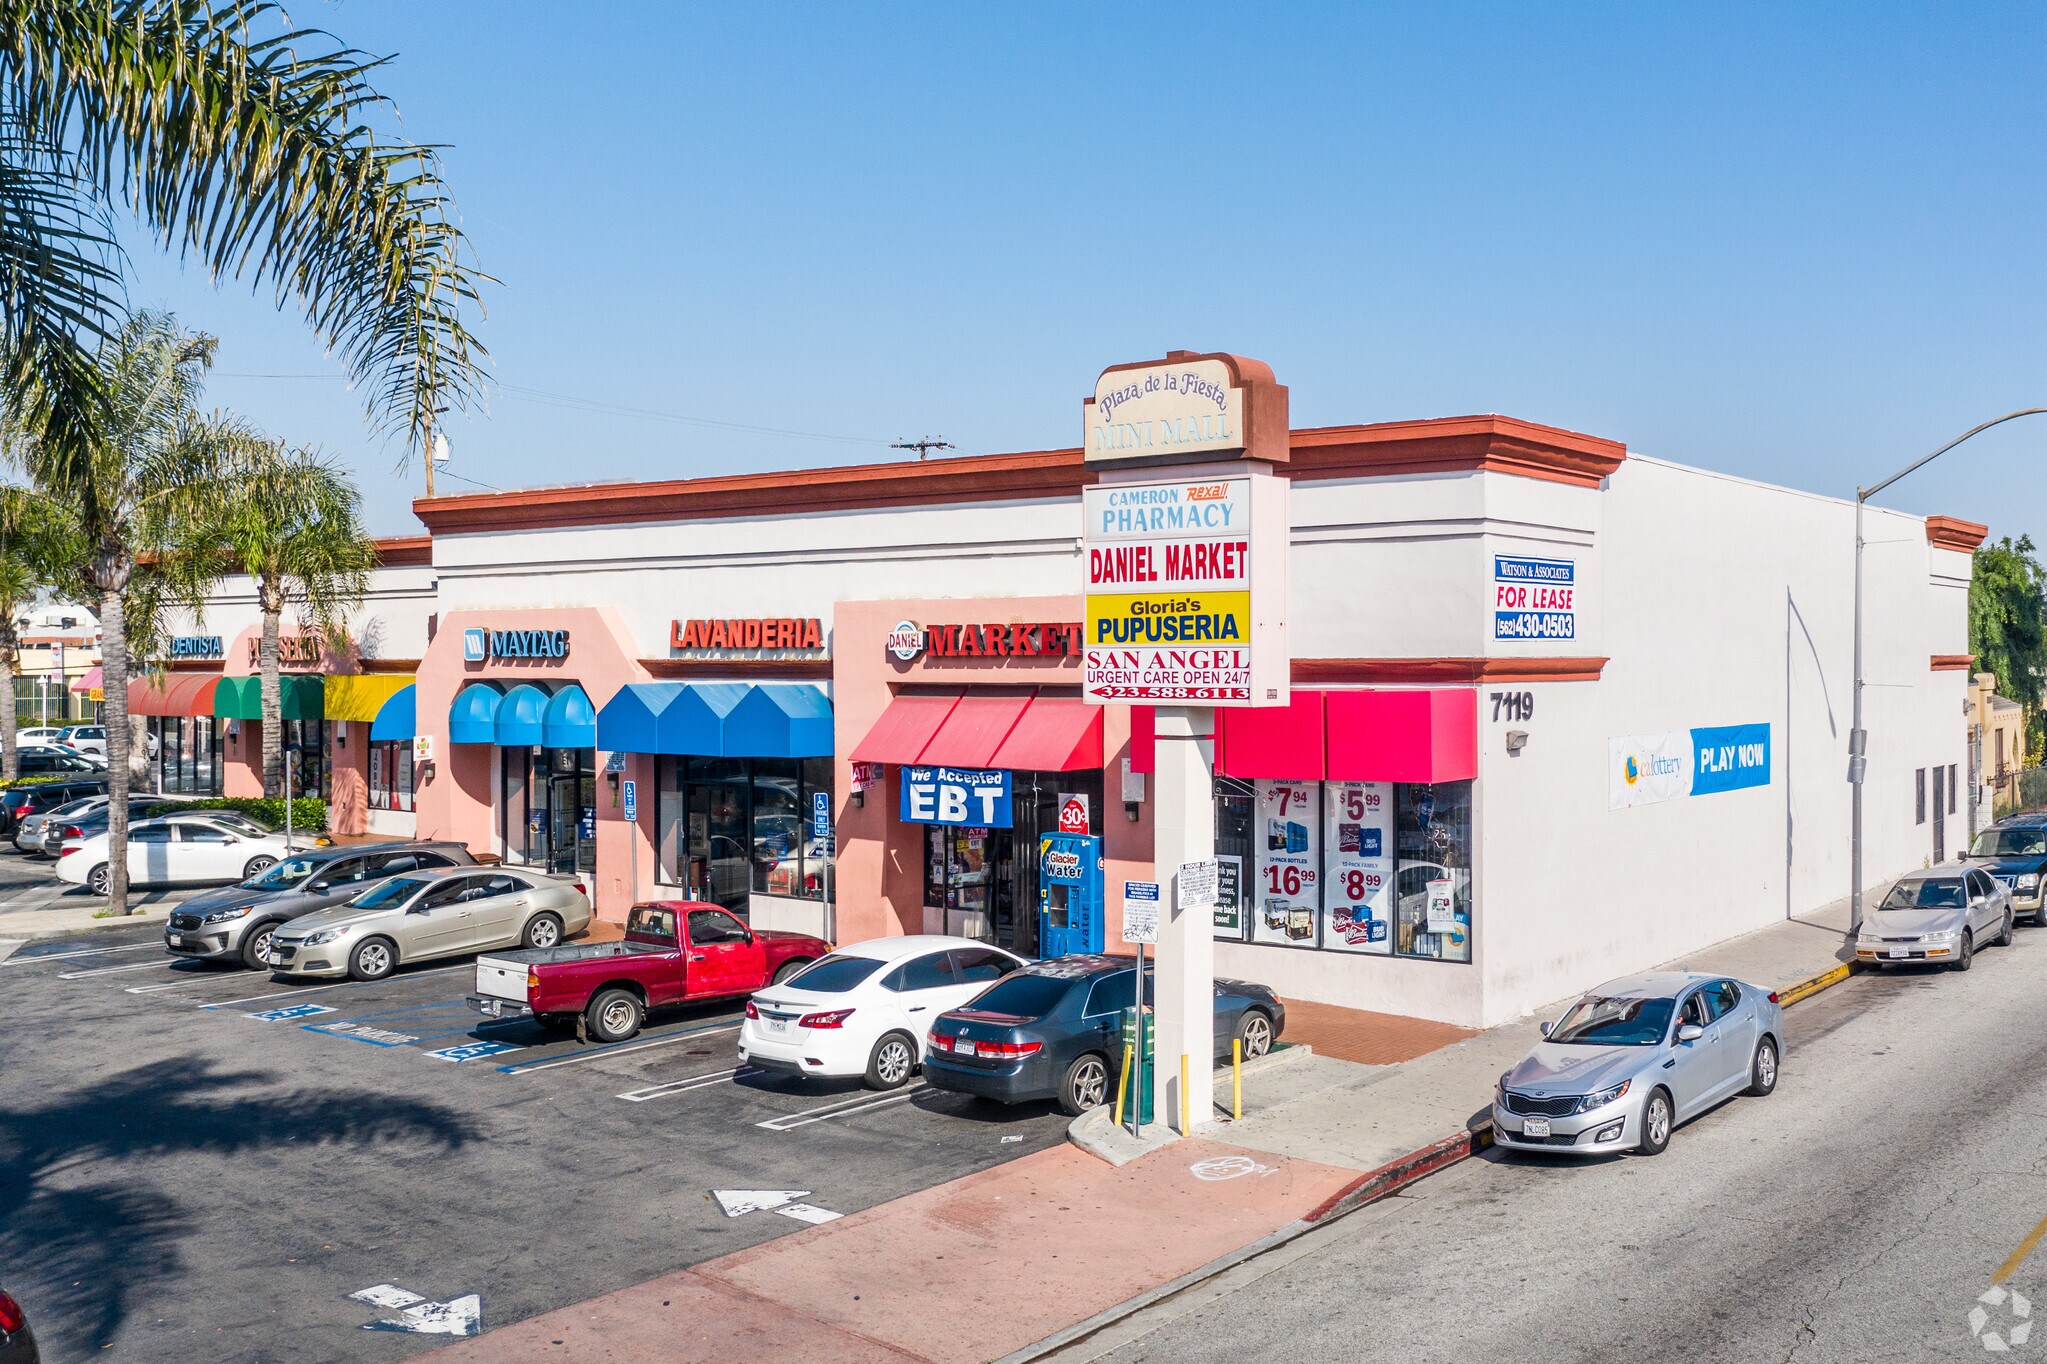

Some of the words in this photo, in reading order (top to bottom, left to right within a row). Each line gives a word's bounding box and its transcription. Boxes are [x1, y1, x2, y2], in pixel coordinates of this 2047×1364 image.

[1100, 384, 1143, 423] Plaza
[1144, 375, 1160, 393] de
[1164, 373, 1177, 391] la
[1180, 373, 1227, 411] Fiesta
[1095, 421, 1153, 451] MINI
[1161, 414, 1233, 445] MALL
[1109, 489, 1179, 507] CAMERON
[1103, 503, 1234, 533] PHARMACY
[1090, 546, 1158, 584] DANIEL
[1165, 542, 1248, 581] MARKET
[1528, 566, 1533, 577] &
[1130, 598, 1201, 616] Gloria's
[1497, 586, 1527, 608] FOR
[1532, 588, 1573, 610] LEASE
[671, 618, 823, 649] LAVANDERIA
[1097, 614, 1240, 643] PUPUSERIA
[172, 636, 222, 654] DENTISTA
[248, 636, 318, 661] PUSERIA
[490, 629, 567, 658] MAYTAG
[889, 633, 922, 649] DANIEL
[926, 622, 1084, 657] MARKET
[1087, 651, 1141, 670] SAN
[1148, 650, 1250, 670] ANGEL
[1087, 671, 1140, 684] URGENT
[1143, 671, 1179, 684] CARE
[1183, 671, 1220, 684] OPEN
[1224, 671, 1250, 684] 24/7
[1101, 686, 1249, 699] 323.588.6113
[1490, 691, 1533, 723] 7119
[1640, 754, 1682, 778] calottery
[1700, 746, 1735, 773] PLAY
[1738, 743, 1764, 768] NOW
[911, 768, 930, 783] We
[937, 769, 1003, 785] Accepted
[910, 783, 1004, 824] EBT
[968, 828, 988, 836] ATM
[1051, 853, 1078, 865] Glacier
[1047, 863, 1082, 878] Water
[1226, 868, 1237, 877] you
[1222, 878, 1234, 887] your
[1215, 915, 1230, 923] soon!
[1224, 905, 1236, 914] back
[1081, 905, 1090, 948] water
[1371, 931, 1385, 939] LIGHT
